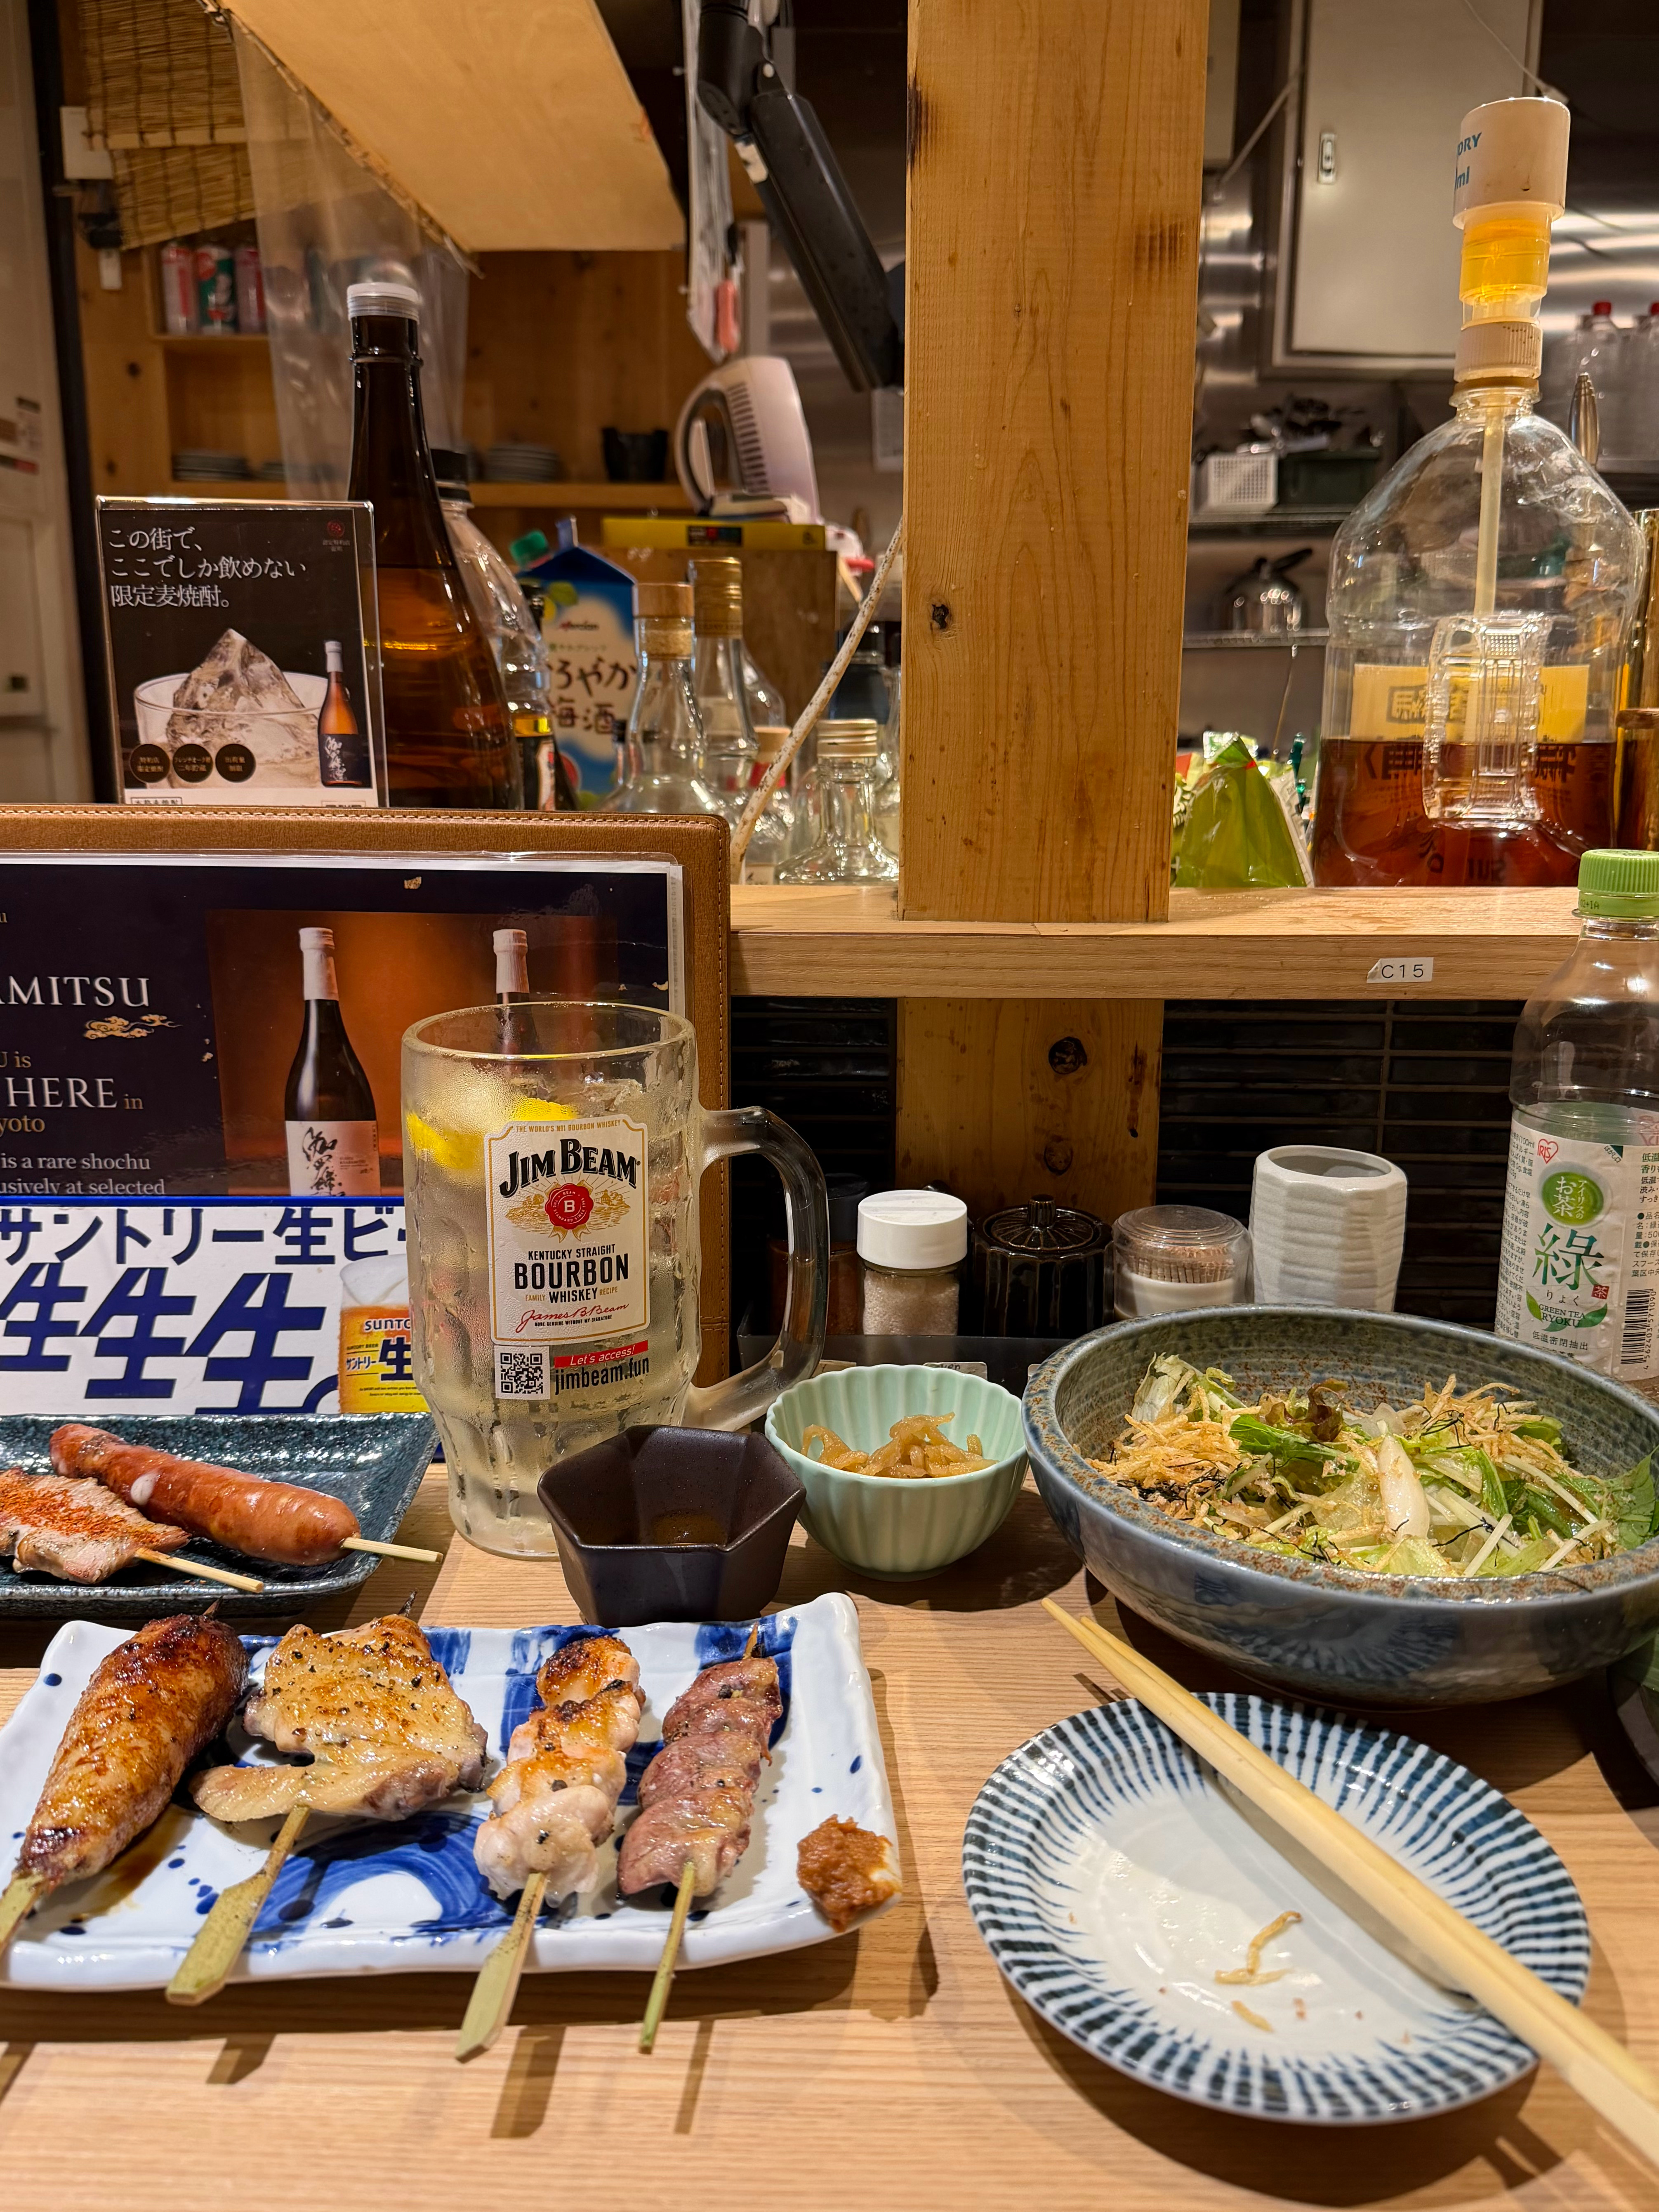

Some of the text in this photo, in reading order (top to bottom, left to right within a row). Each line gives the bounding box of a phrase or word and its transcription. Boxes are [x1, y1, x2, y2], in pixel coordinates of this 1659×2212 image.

[1455, 165, 1470, 191] ml
[108, 526, 203, 552] この街で、
[111, 555, 306, 579] ここでしか飲めない
[110, 584, 230, 608] 限定麦焼酎。
[547, 656, 637, 697] ろやか
[1381, 964, 1424, 979] C15
[0, 976, 150, 1007] MITSU
[14, 1051, 32, 1068] is
[5, 1077, 144, 1110] HERE in
[568, 1123, 594, 1131] BOURBON
[596, 1119, 621, 1129] WHISKEY
[2, 1153, 151, 1170] is a rare shochu
[499, 1138, 637, 1198] JIM BEAM
[1640, 1164, 1659, 1174] 香り
[66, 1181, 83, 1195] at
[88, 1178, 165, 1195] selected
[1641, 1176, 1659, 1184] 低温
[564, 1200, 575, 1213] B
[1552, 1176, 1577, 1217] お茶
[1575, 1180, 1587, 1219] アイリスの
[0, 1207, 406, 1266] サントリー生ビ
[528, 1244, 615, 1260] KENTUCKY STRAIGHT
[515, 1253, 629, 1290] BOURBON
[549, 1287, 598, 1304] WHISKEY
[599, 1286, 618, 1296] RECIPE
[1547, 1290, 1579, 1306] りょく
[1593, 1285, 1607, 1298] 茶
[1539, 1304, 1586, 1319] GREEN TEA
[1647, 1291, 1657, 1323] 571090
[1542, 1312, 1581, 1328] RYOKU
[1532, 1330, 1588, 1351] 低温密閉抽出
[346, 1356, 377, 1370] サントリー
[570, 1344, 636, 1366] Let's access!
[555, 1357, 649, 1395] jimbeam.fun
